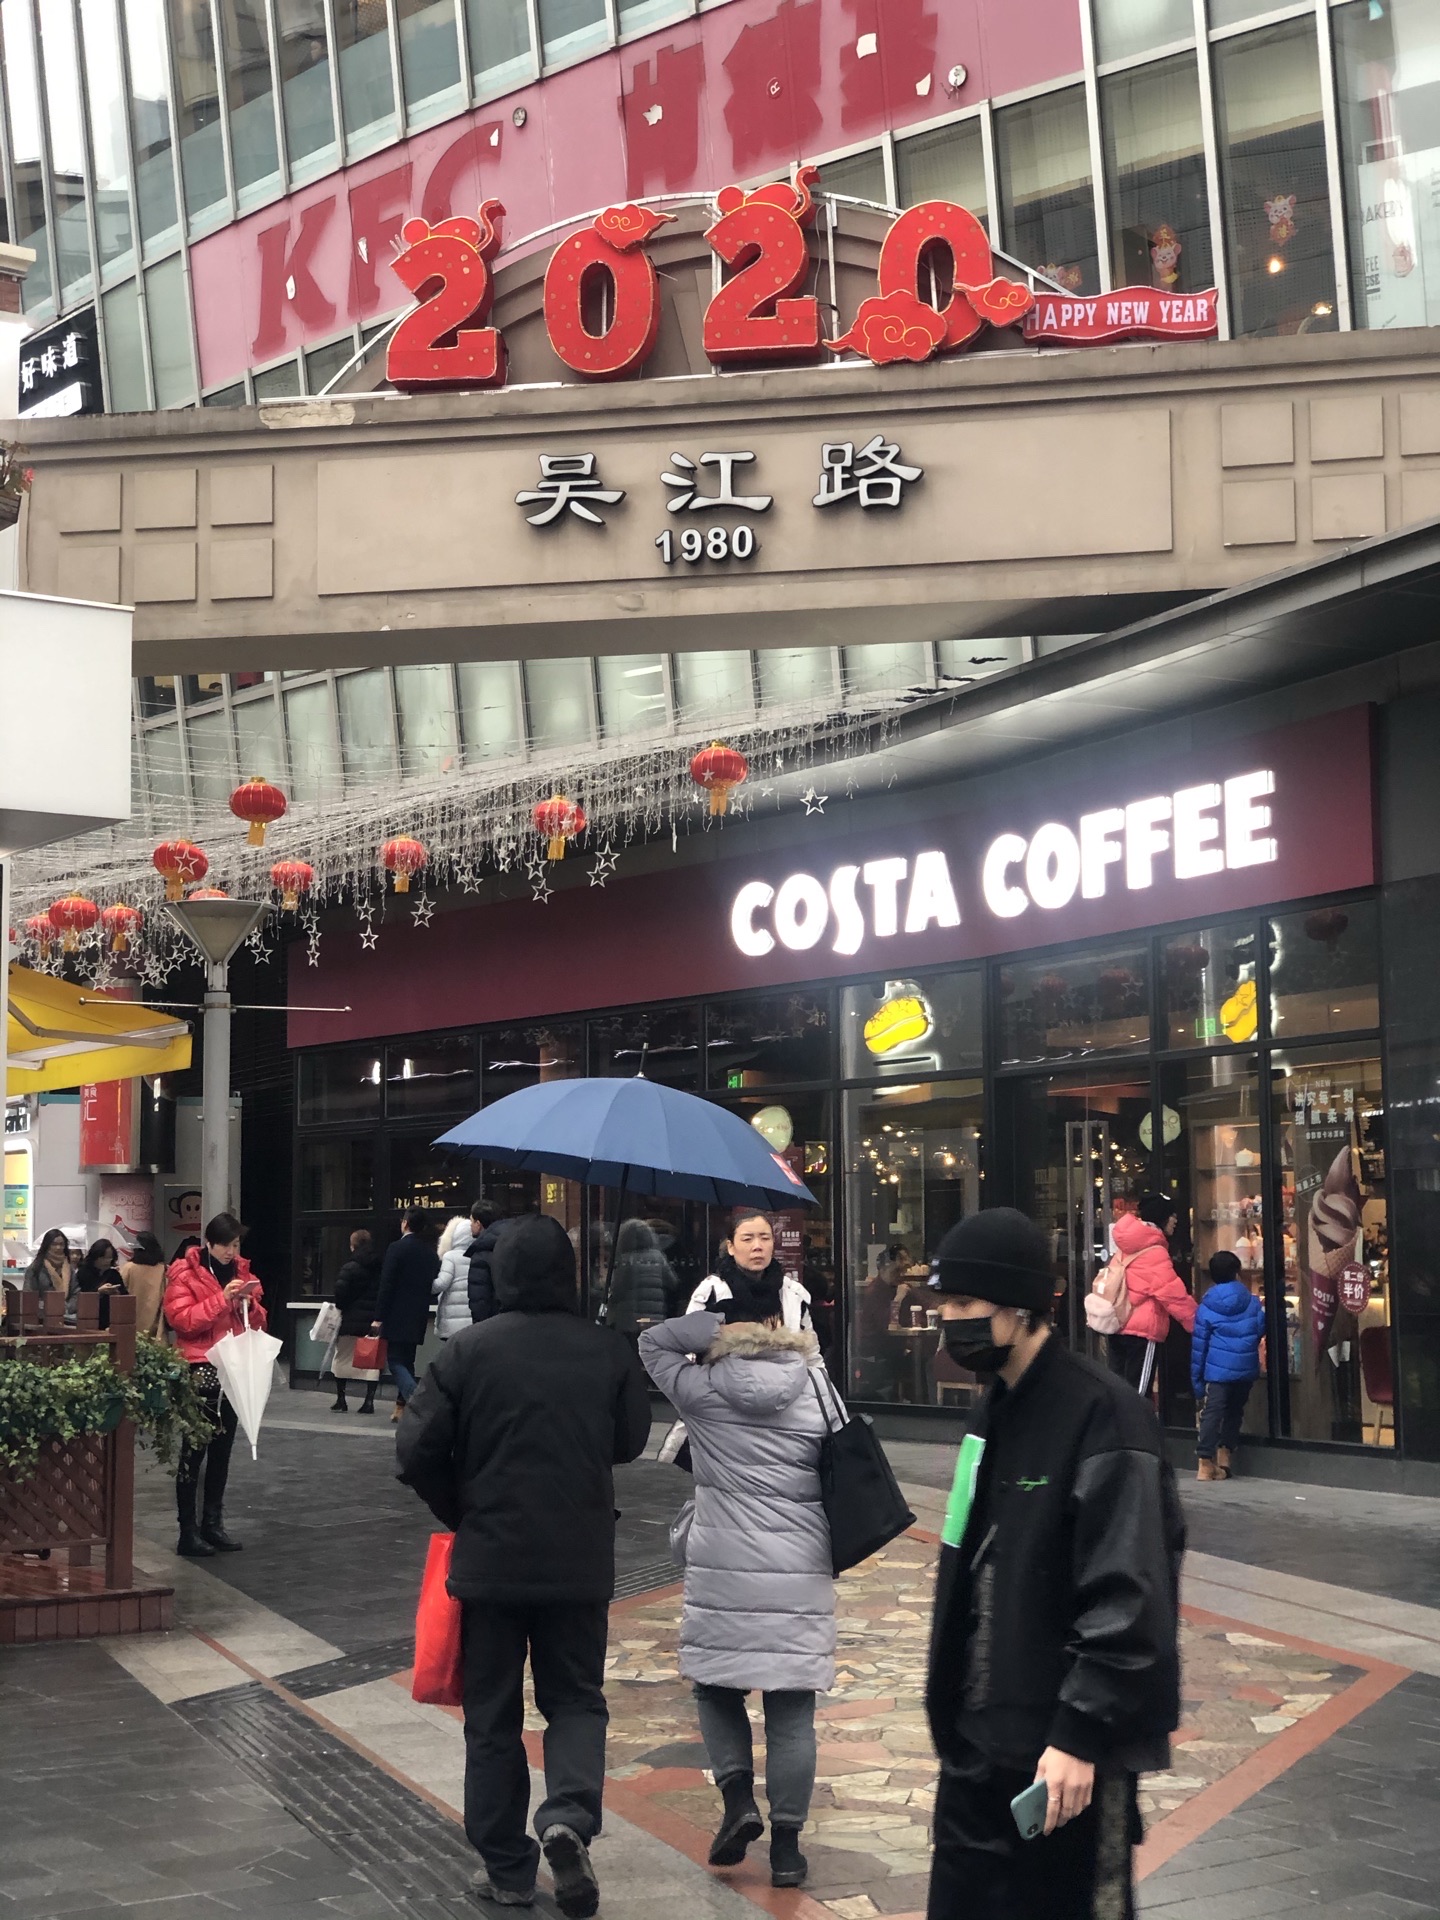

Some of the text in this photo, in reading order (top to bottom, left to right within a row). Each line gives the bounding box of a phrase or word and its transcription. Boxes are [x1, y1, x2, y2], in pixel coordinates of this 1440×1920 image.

[386, 190, 996, 383] 2020
[1026, 299, 1209, 331] HAPPY NEW YEAR
[515, 435, 925, 526] 吴江路
[655, 525, 757, 564] 1980
[731, 769, 1280, 957] COSTA COFFEE
[1313, 1287, 1335, 1303] COSTA
[1343, 1283, 1364, 1300] 半价
